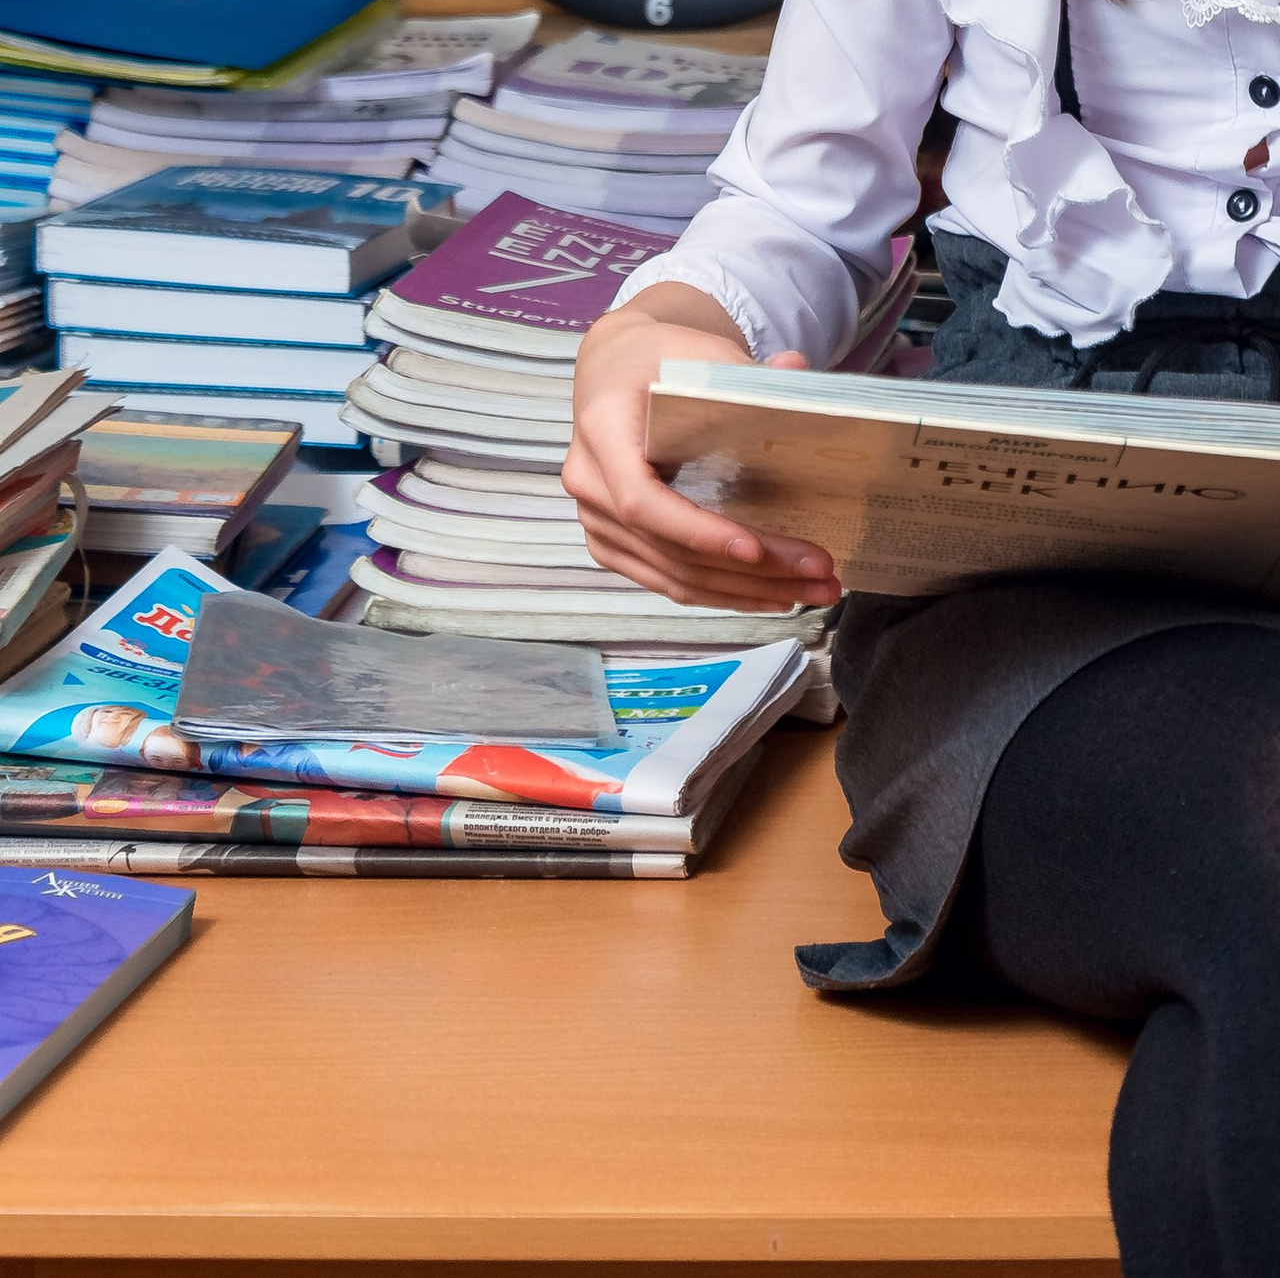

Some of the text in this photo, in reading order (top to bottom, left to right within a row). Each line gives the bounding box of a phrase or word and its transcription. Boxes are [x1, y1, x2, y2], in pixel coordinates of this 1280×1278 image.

[348, 183, 425, 202] 10
[511, 221, 649, 262] ENJ
[438, 293, 596, 328] Student'
[923, 440, 1108, 463] ДИКОЙ ПРИРОДЫ
[988, 438, 1049, 448] МИР
[901, 455, 1246, 501] ТЕЧЕНИЮ
[940, 476, 1060, 499] РЕК
[465, 813, 509, 822] колледжа.
[464, 823, 528, 834] волонтёрского
[530, 825, 561, 834] отдела
[580, 827, 611, 836] добро»
